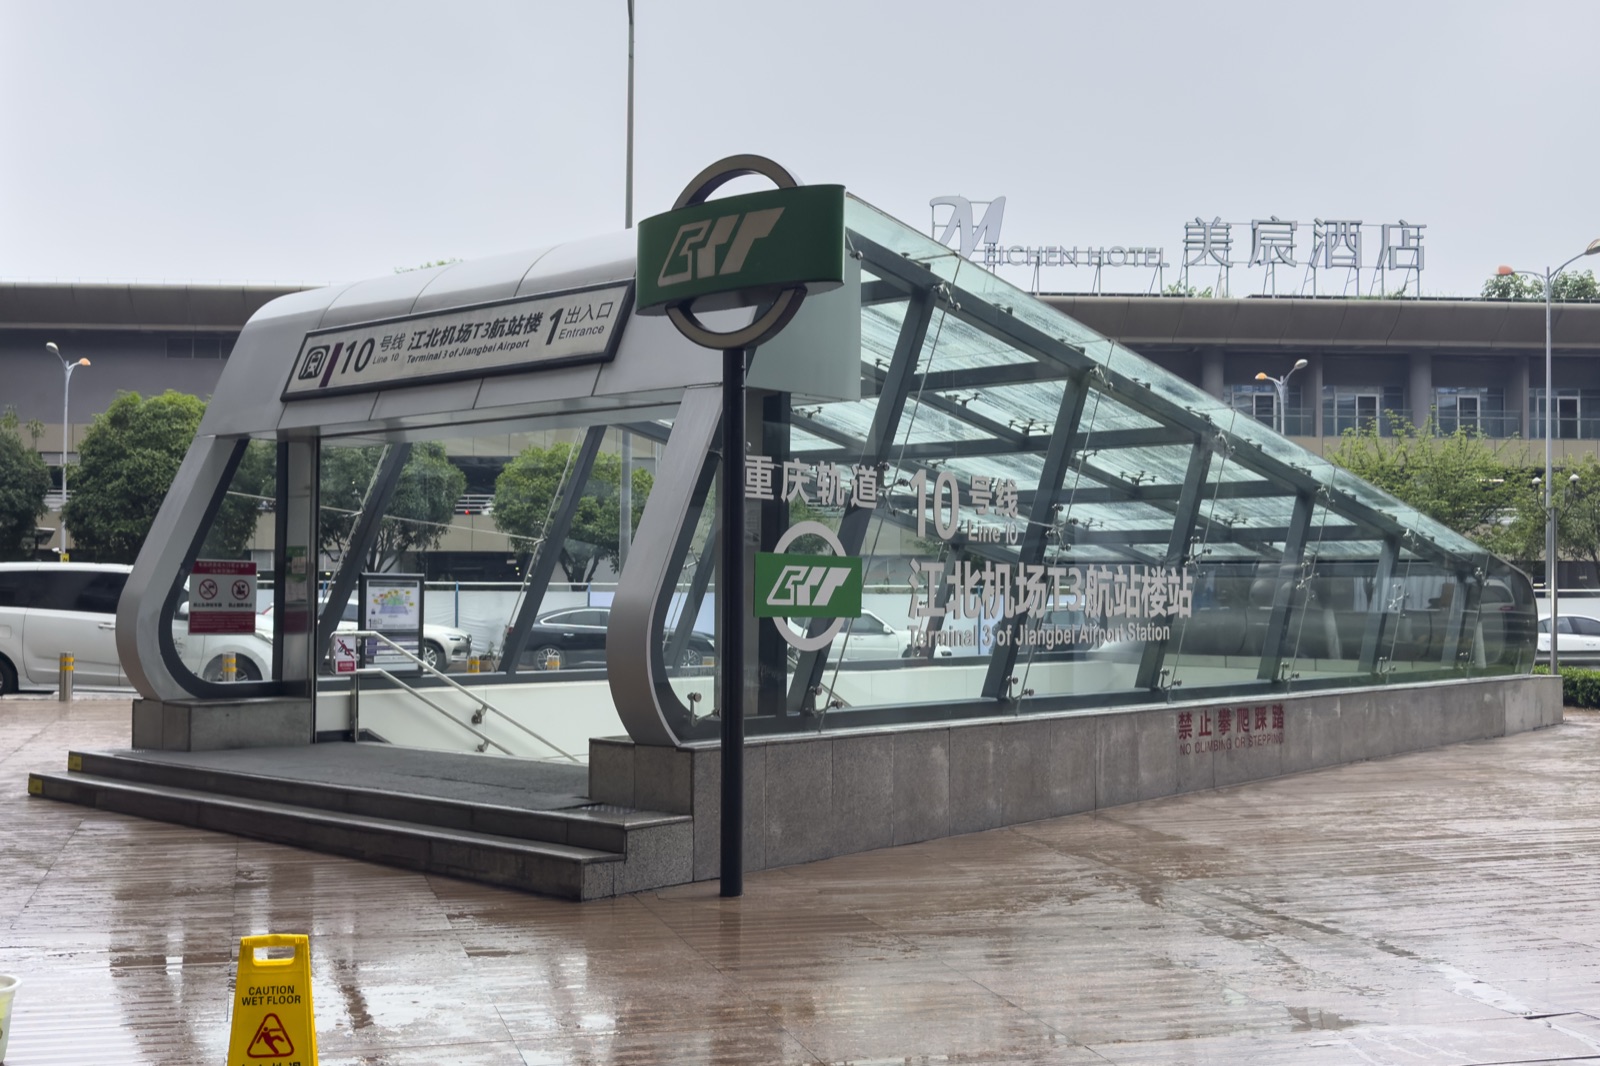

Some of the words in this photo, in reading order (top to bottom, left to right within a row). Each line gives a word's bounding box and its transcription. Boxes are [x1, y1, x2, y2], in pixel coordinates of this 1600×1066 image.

[1183, 215, 1427, 271] 美宸酒店
[1088, 245, 1170, 268] HOTEL
[564, 302, 614, 325] 出入口
[407, 312, 543, 351] 江北机场T3航站楼
[558, 325, 605, 340] Entrance
[372, 355, 388, 365] Line
[391, 353, 399, 362] 10
[407, 350, 442, 364] Terminal
[442, 350, 449, 359] 3
[449, 348, 458, 358] of
[458, 342, 497, 357] Jiangbei
[498, 339, 530, 352] Airport
[744, 455, 877, 509] 重庆轨道
[967, 520, 1001, 542] Line
[1005, 521, 1018, 545] 10
[908, 558, 1193, 619] 江北机场T3航站楼站
[907, 625, 978, 648] Terminal
[982, 624, 995, 646] 3
[997, 624, 1013, 647] of
[1015, 624, 1076, 650] Jiangbei
[1078, 623, 1124, 645] Airport
[1127, 622, 1170, 642] Station
[1179, 704, 1284, 740] 禁止攀爬踩踏
[1180, 743, 1192, 755] NO
[1195, 738, 1232, 754] CLIMBING
[1235, 737, 1245, 749] OR
[1248, 732, 1284, 748] STEPPING
[242, 997, 264, 1006] WET
[267, 995, 302, 1005] FLOOR
[248, 985, 295, 996] CAUTION
